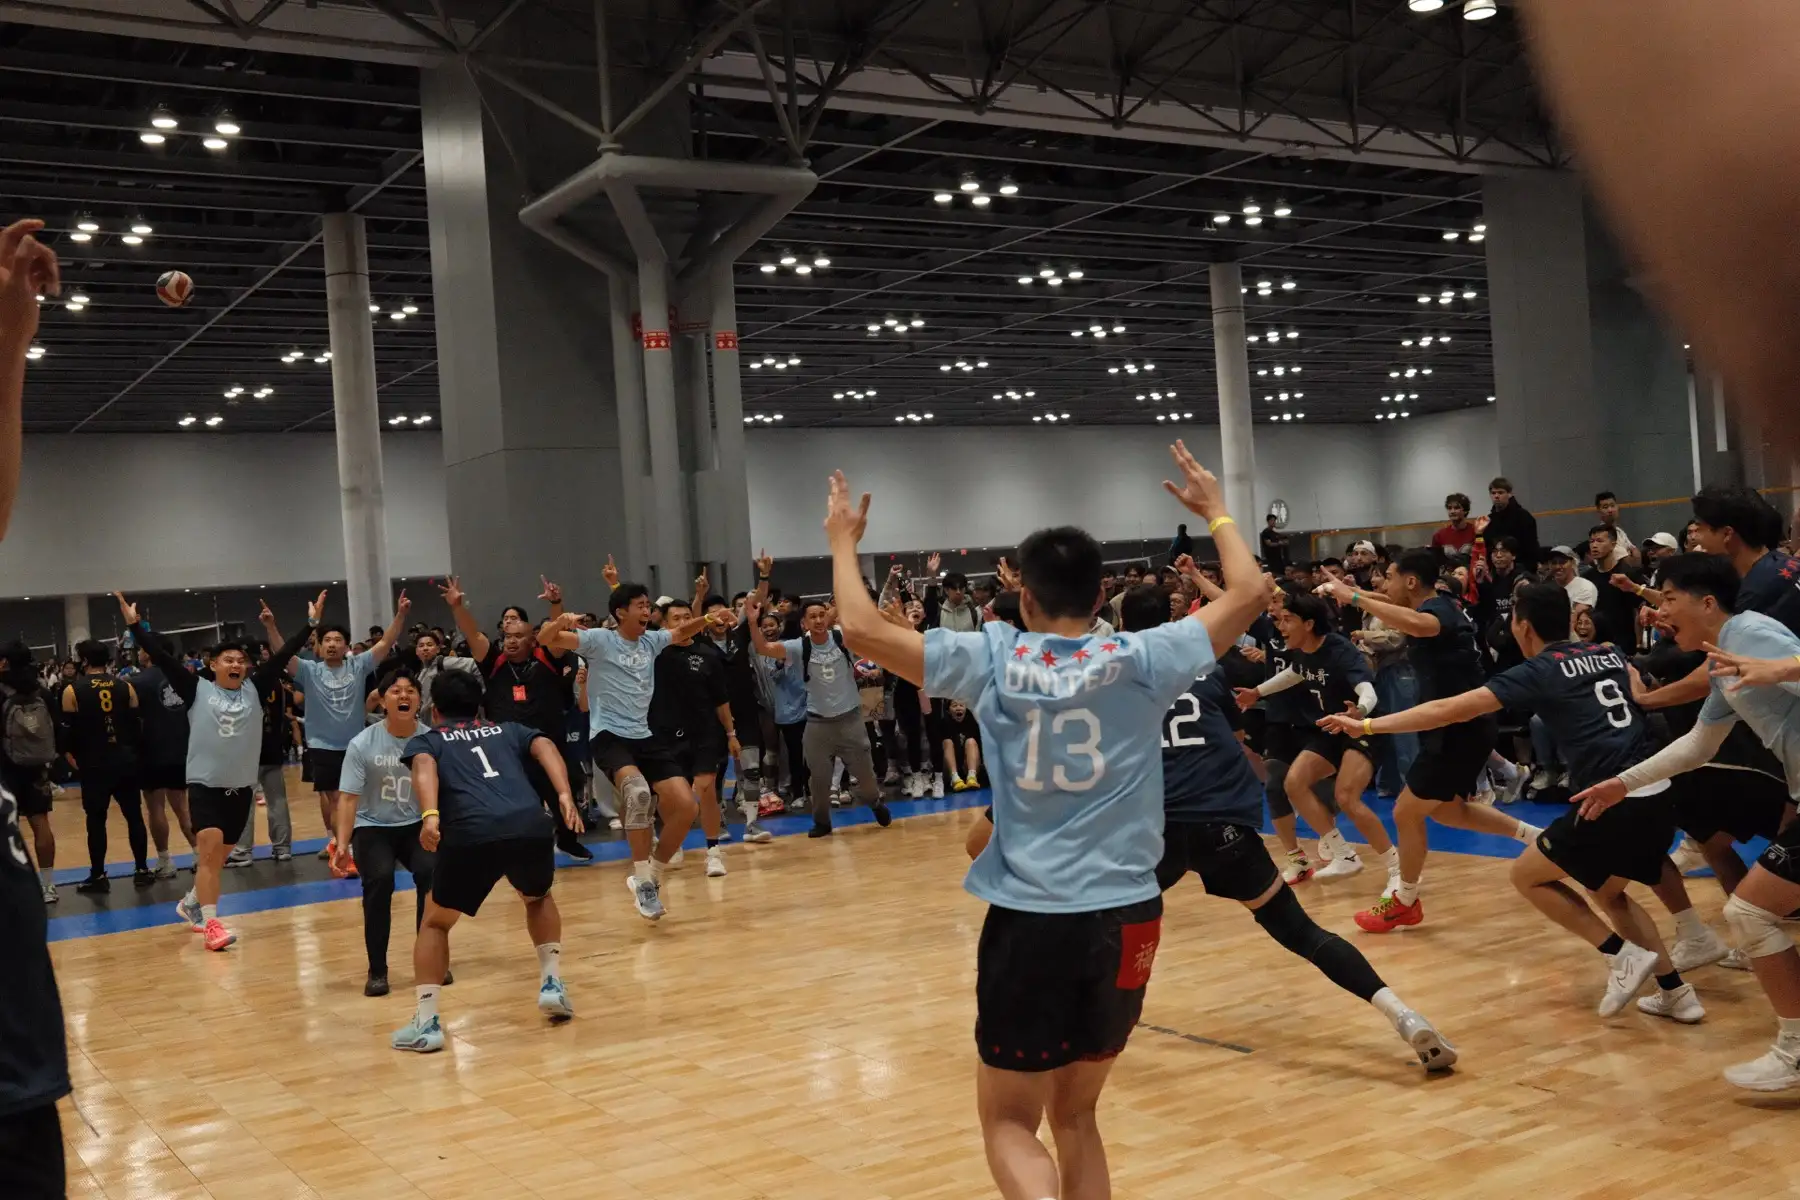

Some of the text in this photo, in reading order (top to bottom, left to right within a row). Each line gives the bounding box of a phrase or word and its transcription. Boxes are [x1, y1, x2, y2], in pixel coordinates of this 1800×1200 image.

[822, 664, 836, 682] 5
[1005, 659, 1123, 697] UNITED
[1560, 653, 1624, 678] UNITED
[98, 690, 113, 712] 8
[1594, 678, 1632, 728] 9
[441, 725, 503, 742] UNITED
[1161, 692, 1206, 747] 2
[470, 745, 500, 778] 1
[1016, 708, 1106, 791] 13
[380, 775, 413, 803] 20
